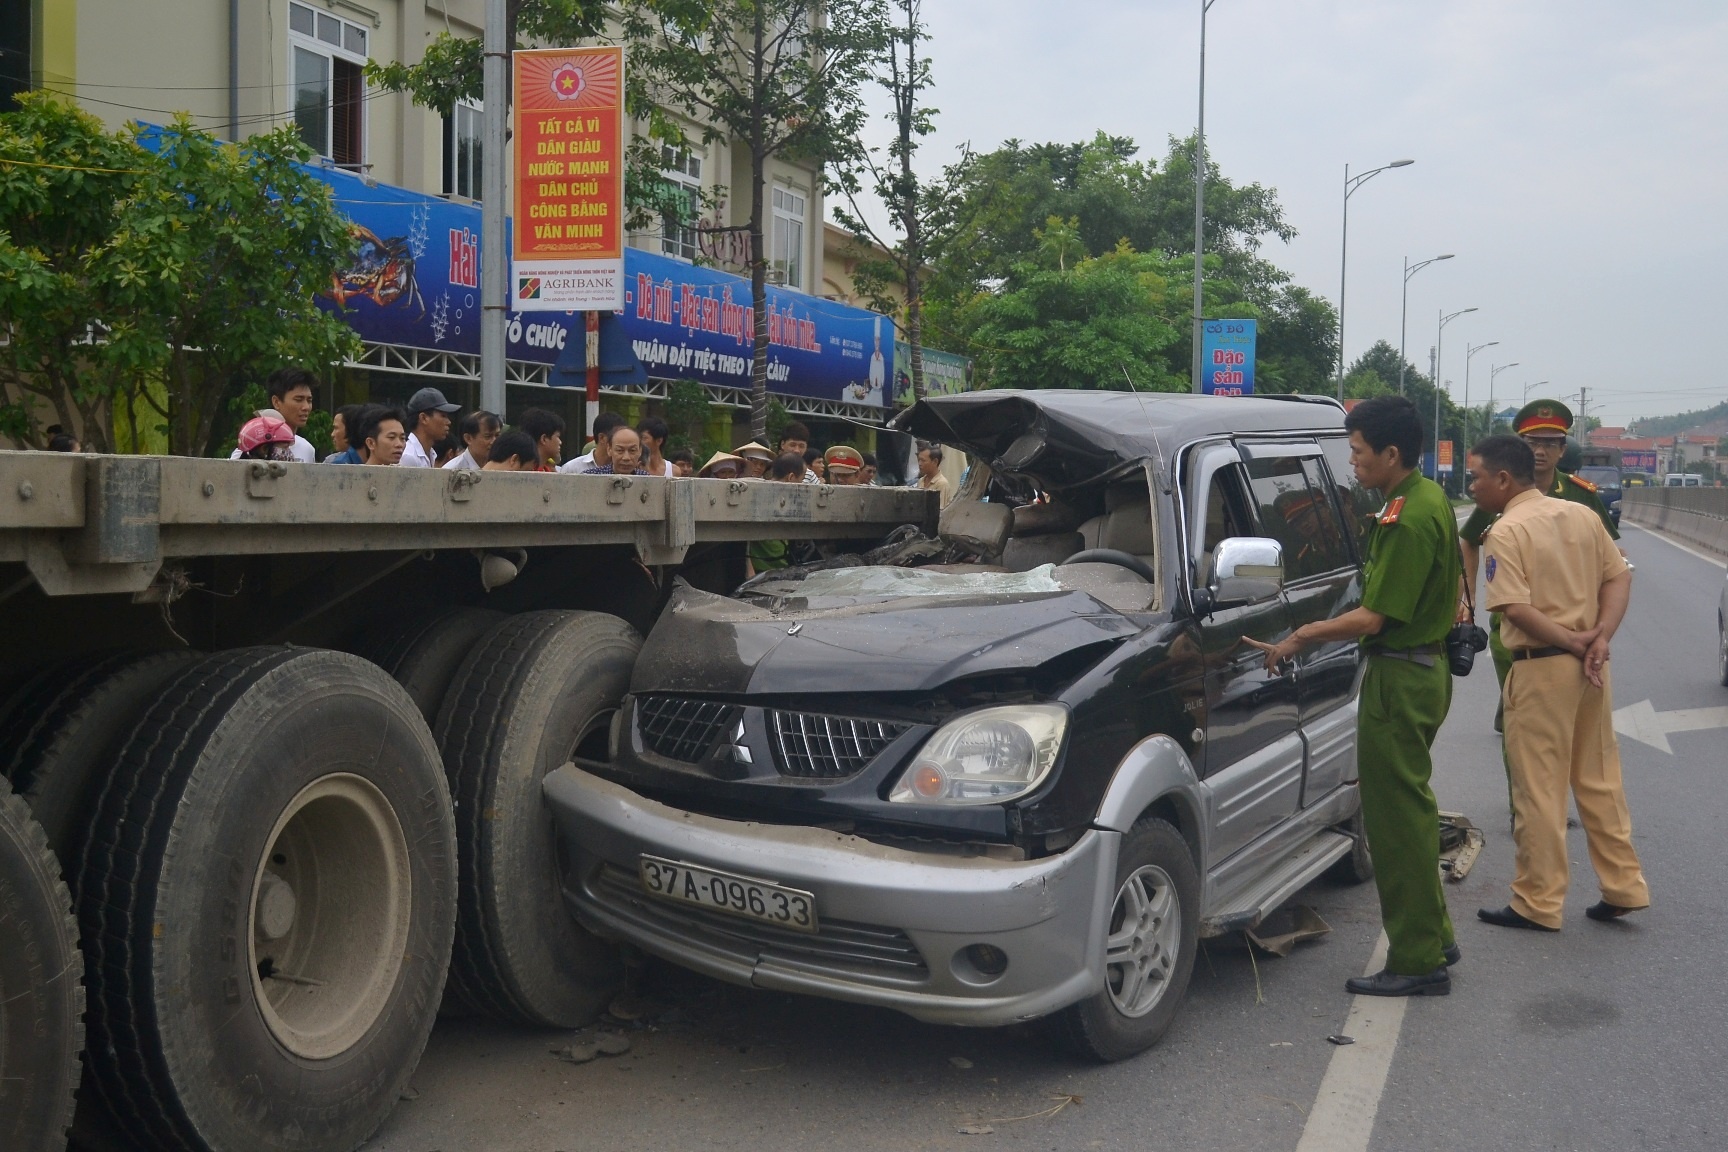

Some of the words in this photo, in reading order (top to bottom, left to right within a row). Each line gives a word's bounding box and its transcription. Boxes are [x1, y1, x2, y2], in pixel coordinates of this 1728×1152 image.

[538, 116, 562, 134] TẤT
[565, 116, 584, 133] CẢ
[587, 117, 600, 133] VÌ
[537, 139, 566, 155] DÂN
[569, 138, 601, 154] GIÀU
[529, 160, 564, 176] NƯỚC
[568, 161, 609, 177] MẠNH
[540, 180, 567, 197] DÂN
[571, 178, 598, 196] CHỦ
[530, 202, 567, 218] CÔNG
[571, 199, 607, 217] BẰNG
[534, 223, 562, 239] VĂN
[566, 224, 603, 238] MINH
[449, 227, 478, 288] Hải
[543, 278, 614, 289] AGRIBANK
[637, 272, 652, 320] Dê
[654, 277, 672, 324] núi
[680, 283, 701, 337] Đặc
[702, 285, 720, 333] sản
[721, 285, 743, 346] đồng
[526, 321, 567, 350] CHỨC
[632, 338, 668, 369] NHẬN
[669, 341, 693, 372] ĐẶT
[694, 347, 717, 376] TIỆC
[718, 354, 745, 376] THEO
[1213, 349, 1244, 366] Đặc
[1213, 366, 1243, 384] sản
[1183, 698, 1203, 713] JOLIE
[644, 862, 810, 926] 37A-096.33
